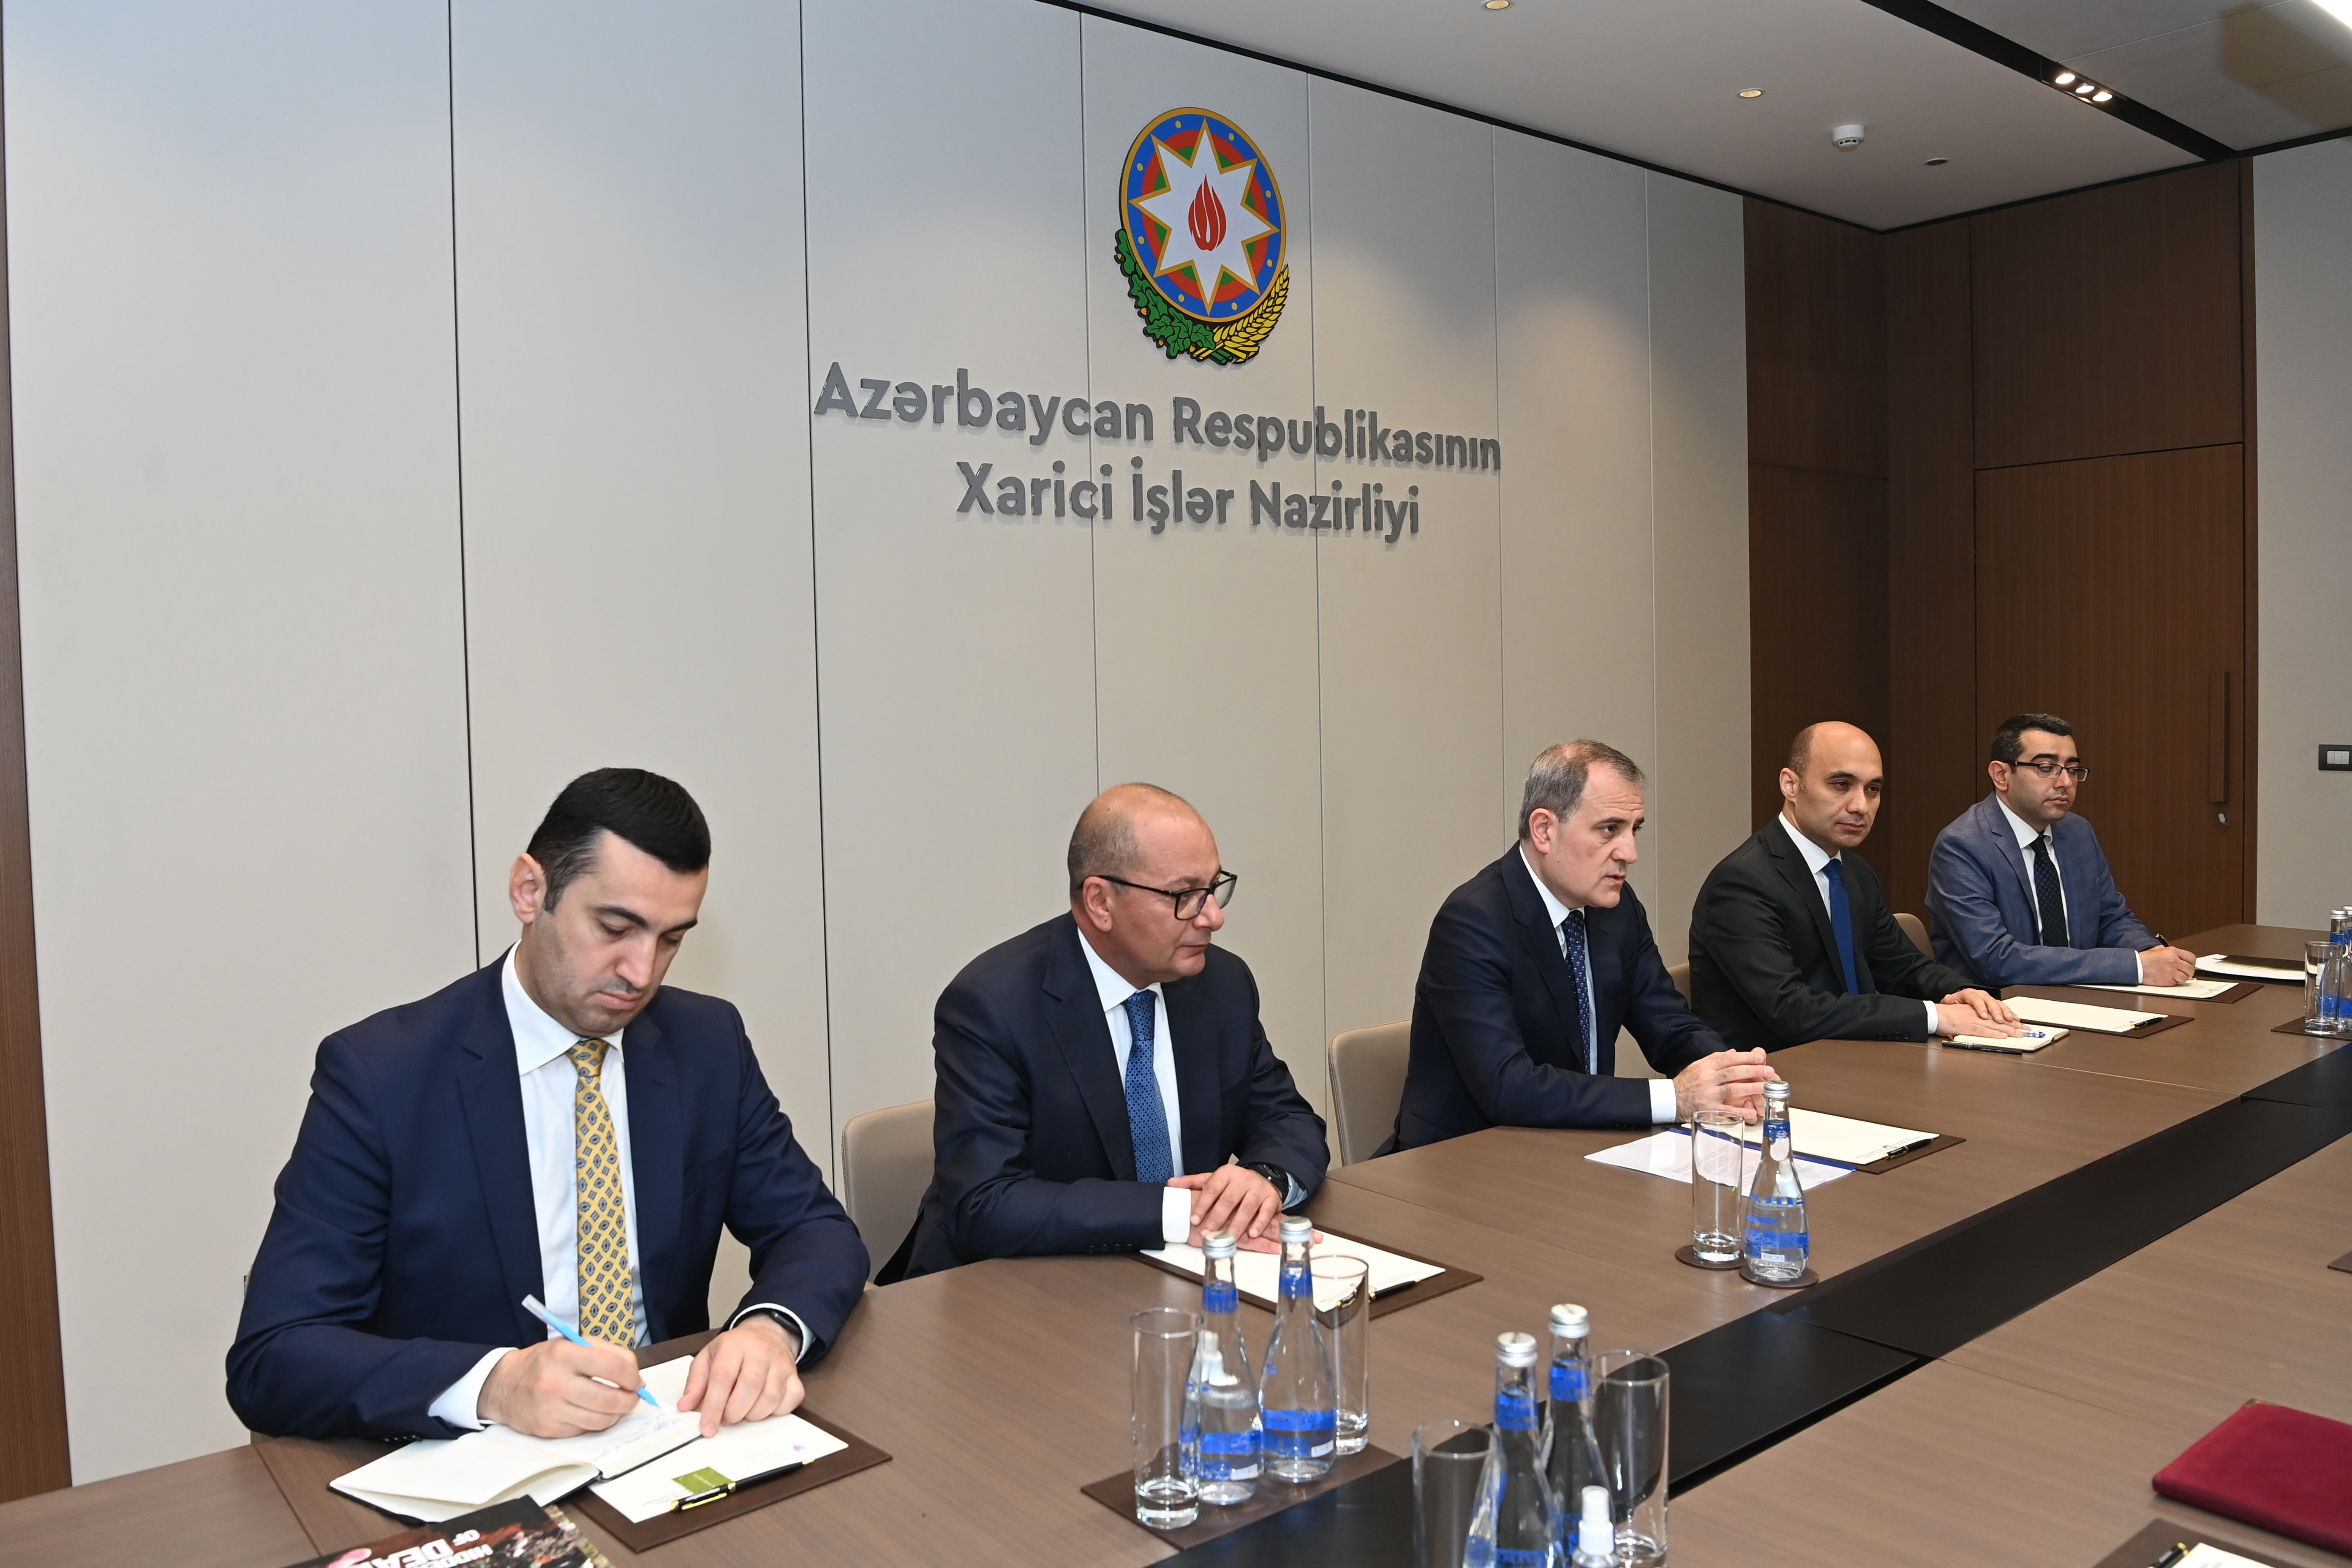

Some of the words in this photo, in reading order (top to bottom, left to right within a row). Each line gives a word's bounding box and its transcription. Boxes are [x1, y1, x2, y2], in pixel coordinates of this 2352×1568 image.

[814, 362, 1154, 446] Azərbaycan
[1172, 396, 1501, 470] Respublikasının
[956, 460, 1113, 519] Xarici
[1131, 456, 1234, 534] İşlər
[1250, 479, 1419, 544] Nazirliyi
[416, 1544, 493, 1568] HIDDE
[452, 1529, 480, 1546] OF
